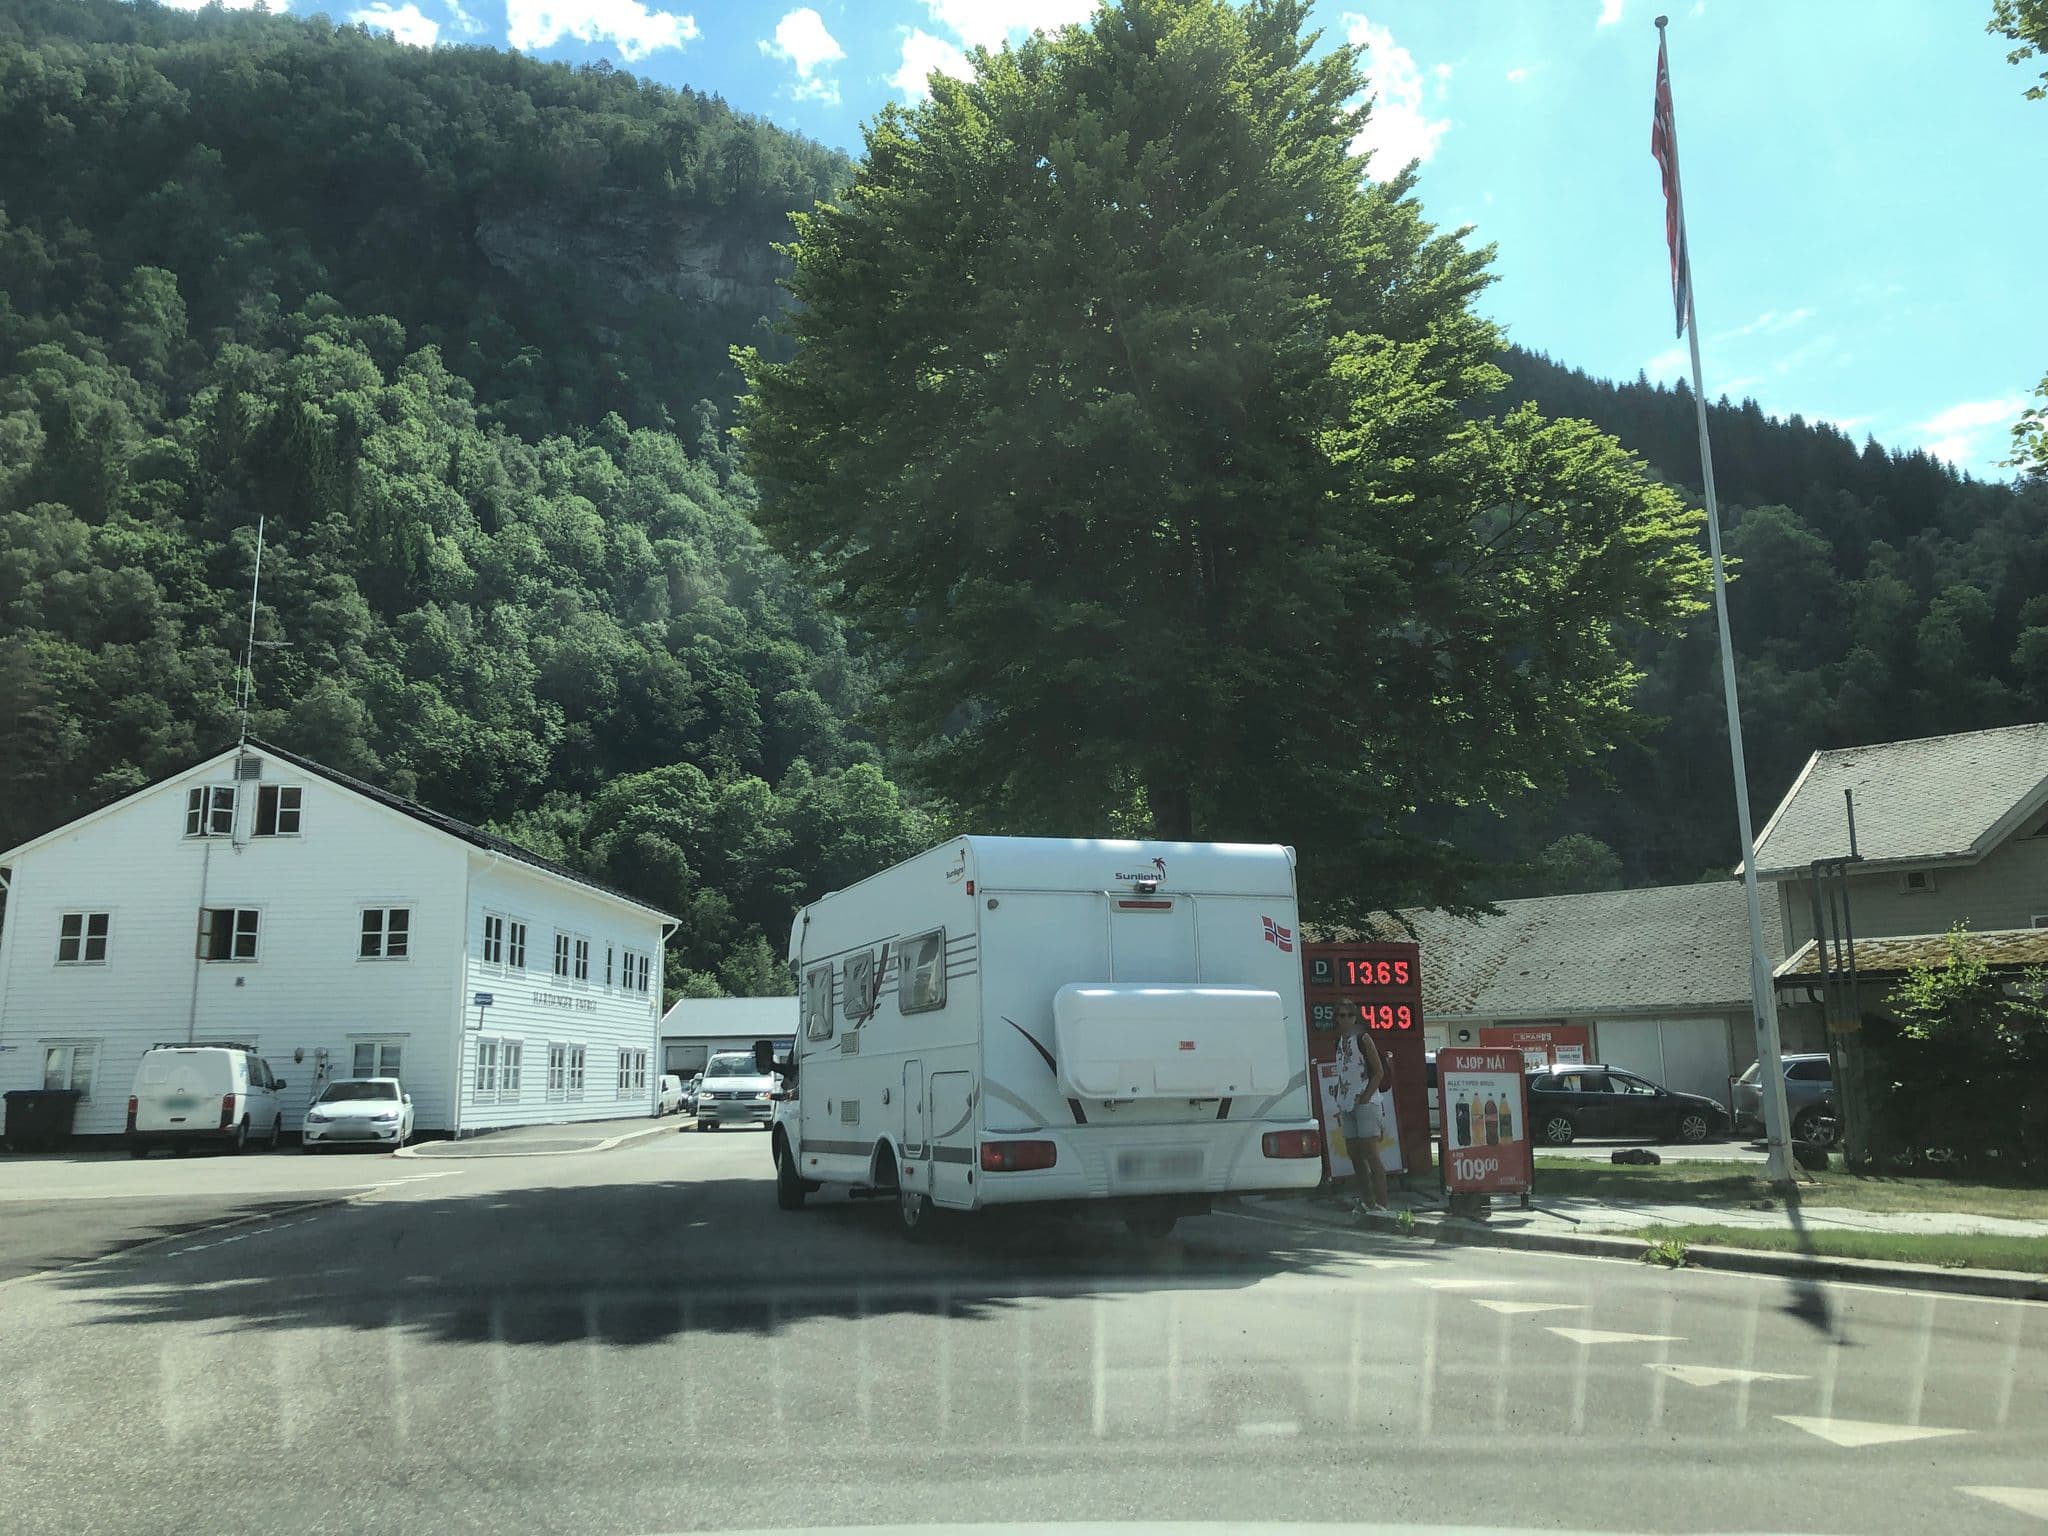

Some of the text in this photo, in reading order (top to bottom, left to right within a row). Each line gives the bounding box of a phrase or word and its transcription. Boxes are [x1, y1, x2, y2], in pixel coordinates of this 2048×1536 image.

[1115, 872, 1163, 881] Sunlight
[1315, 961, 1327, 975] D
[1313, 1006, 1333, 1019] 95
[1361, 1005, 1411, 1029] 4.99
[1456, 1054, 1505, 1070] KJØP NÅ!
